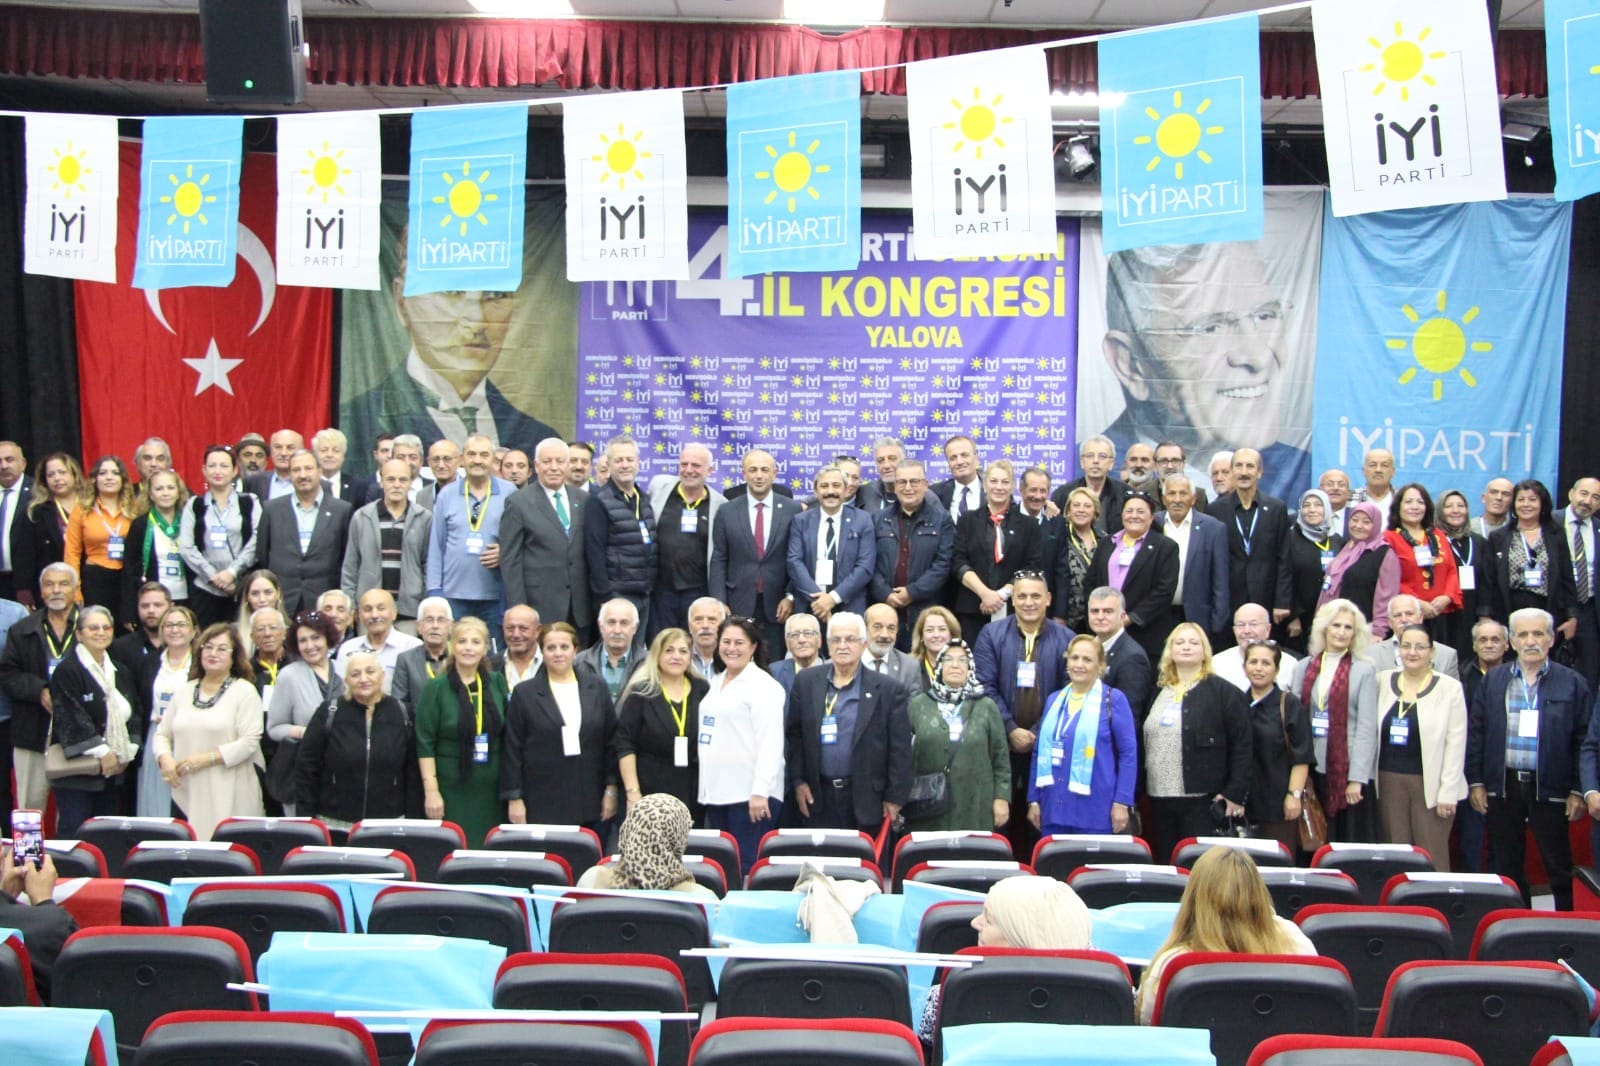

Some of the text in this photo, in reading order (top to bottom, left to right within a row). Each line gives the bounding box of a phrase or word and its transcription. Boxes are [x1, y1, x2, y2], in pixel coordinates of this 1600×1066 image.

[1374, 103, 1443, 166] İYİ
[1378, 163, 1446, 187] PARTİ
[953, 163, 1008, 216] İYİ
[50, 203, 86, 244] İYİ
[305, 208, 345, 250] İYİ
[600, 195, 646, 241] İYİ
[954, 217, 1010, 235] PARTİ
[48, 247, 86, 260] PARTİ
[304, 254, 344, 266] PARTİ
[599, 244, 647, 259] PARTİ
[820, 266, 1066, 317] KONGRESİ
[611, 309, 649, 321] PARTİ
[866, 326, 964, 348] YALOVA
